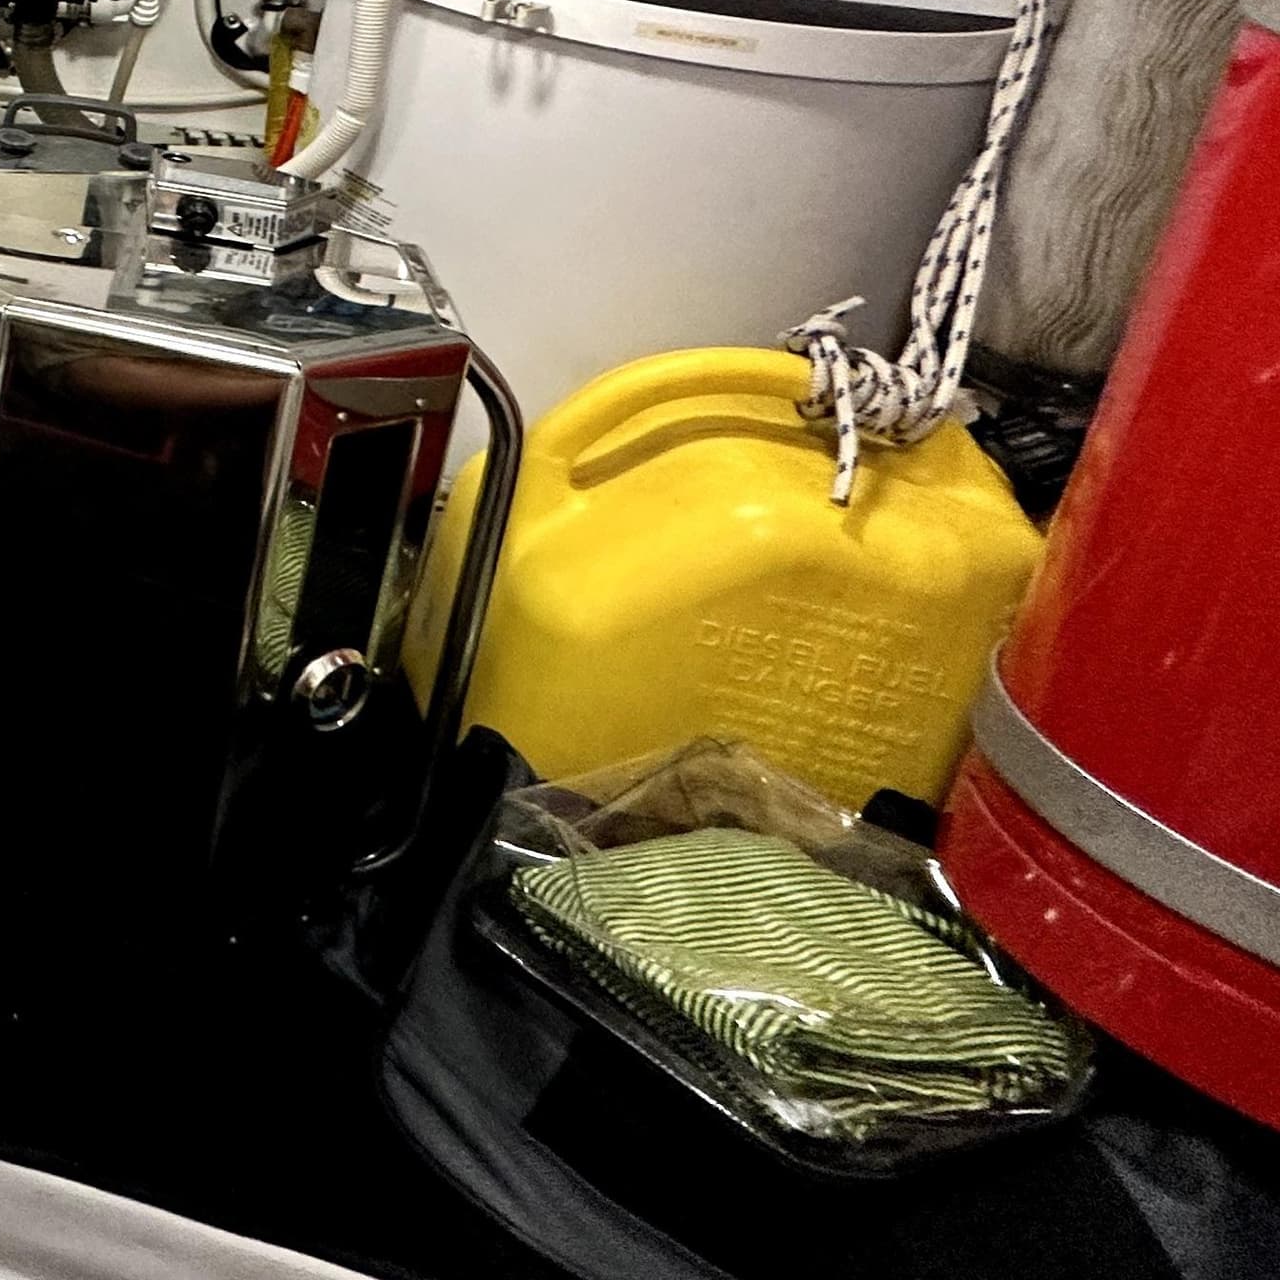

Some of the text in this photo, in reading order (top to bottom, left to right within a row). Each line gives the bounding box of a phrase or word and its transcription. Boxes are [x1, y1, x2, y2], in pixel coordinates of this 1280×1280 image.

[695, 618, 951, 701] DIESEL FUEL
[733, 656, 904, 712] DANGER
